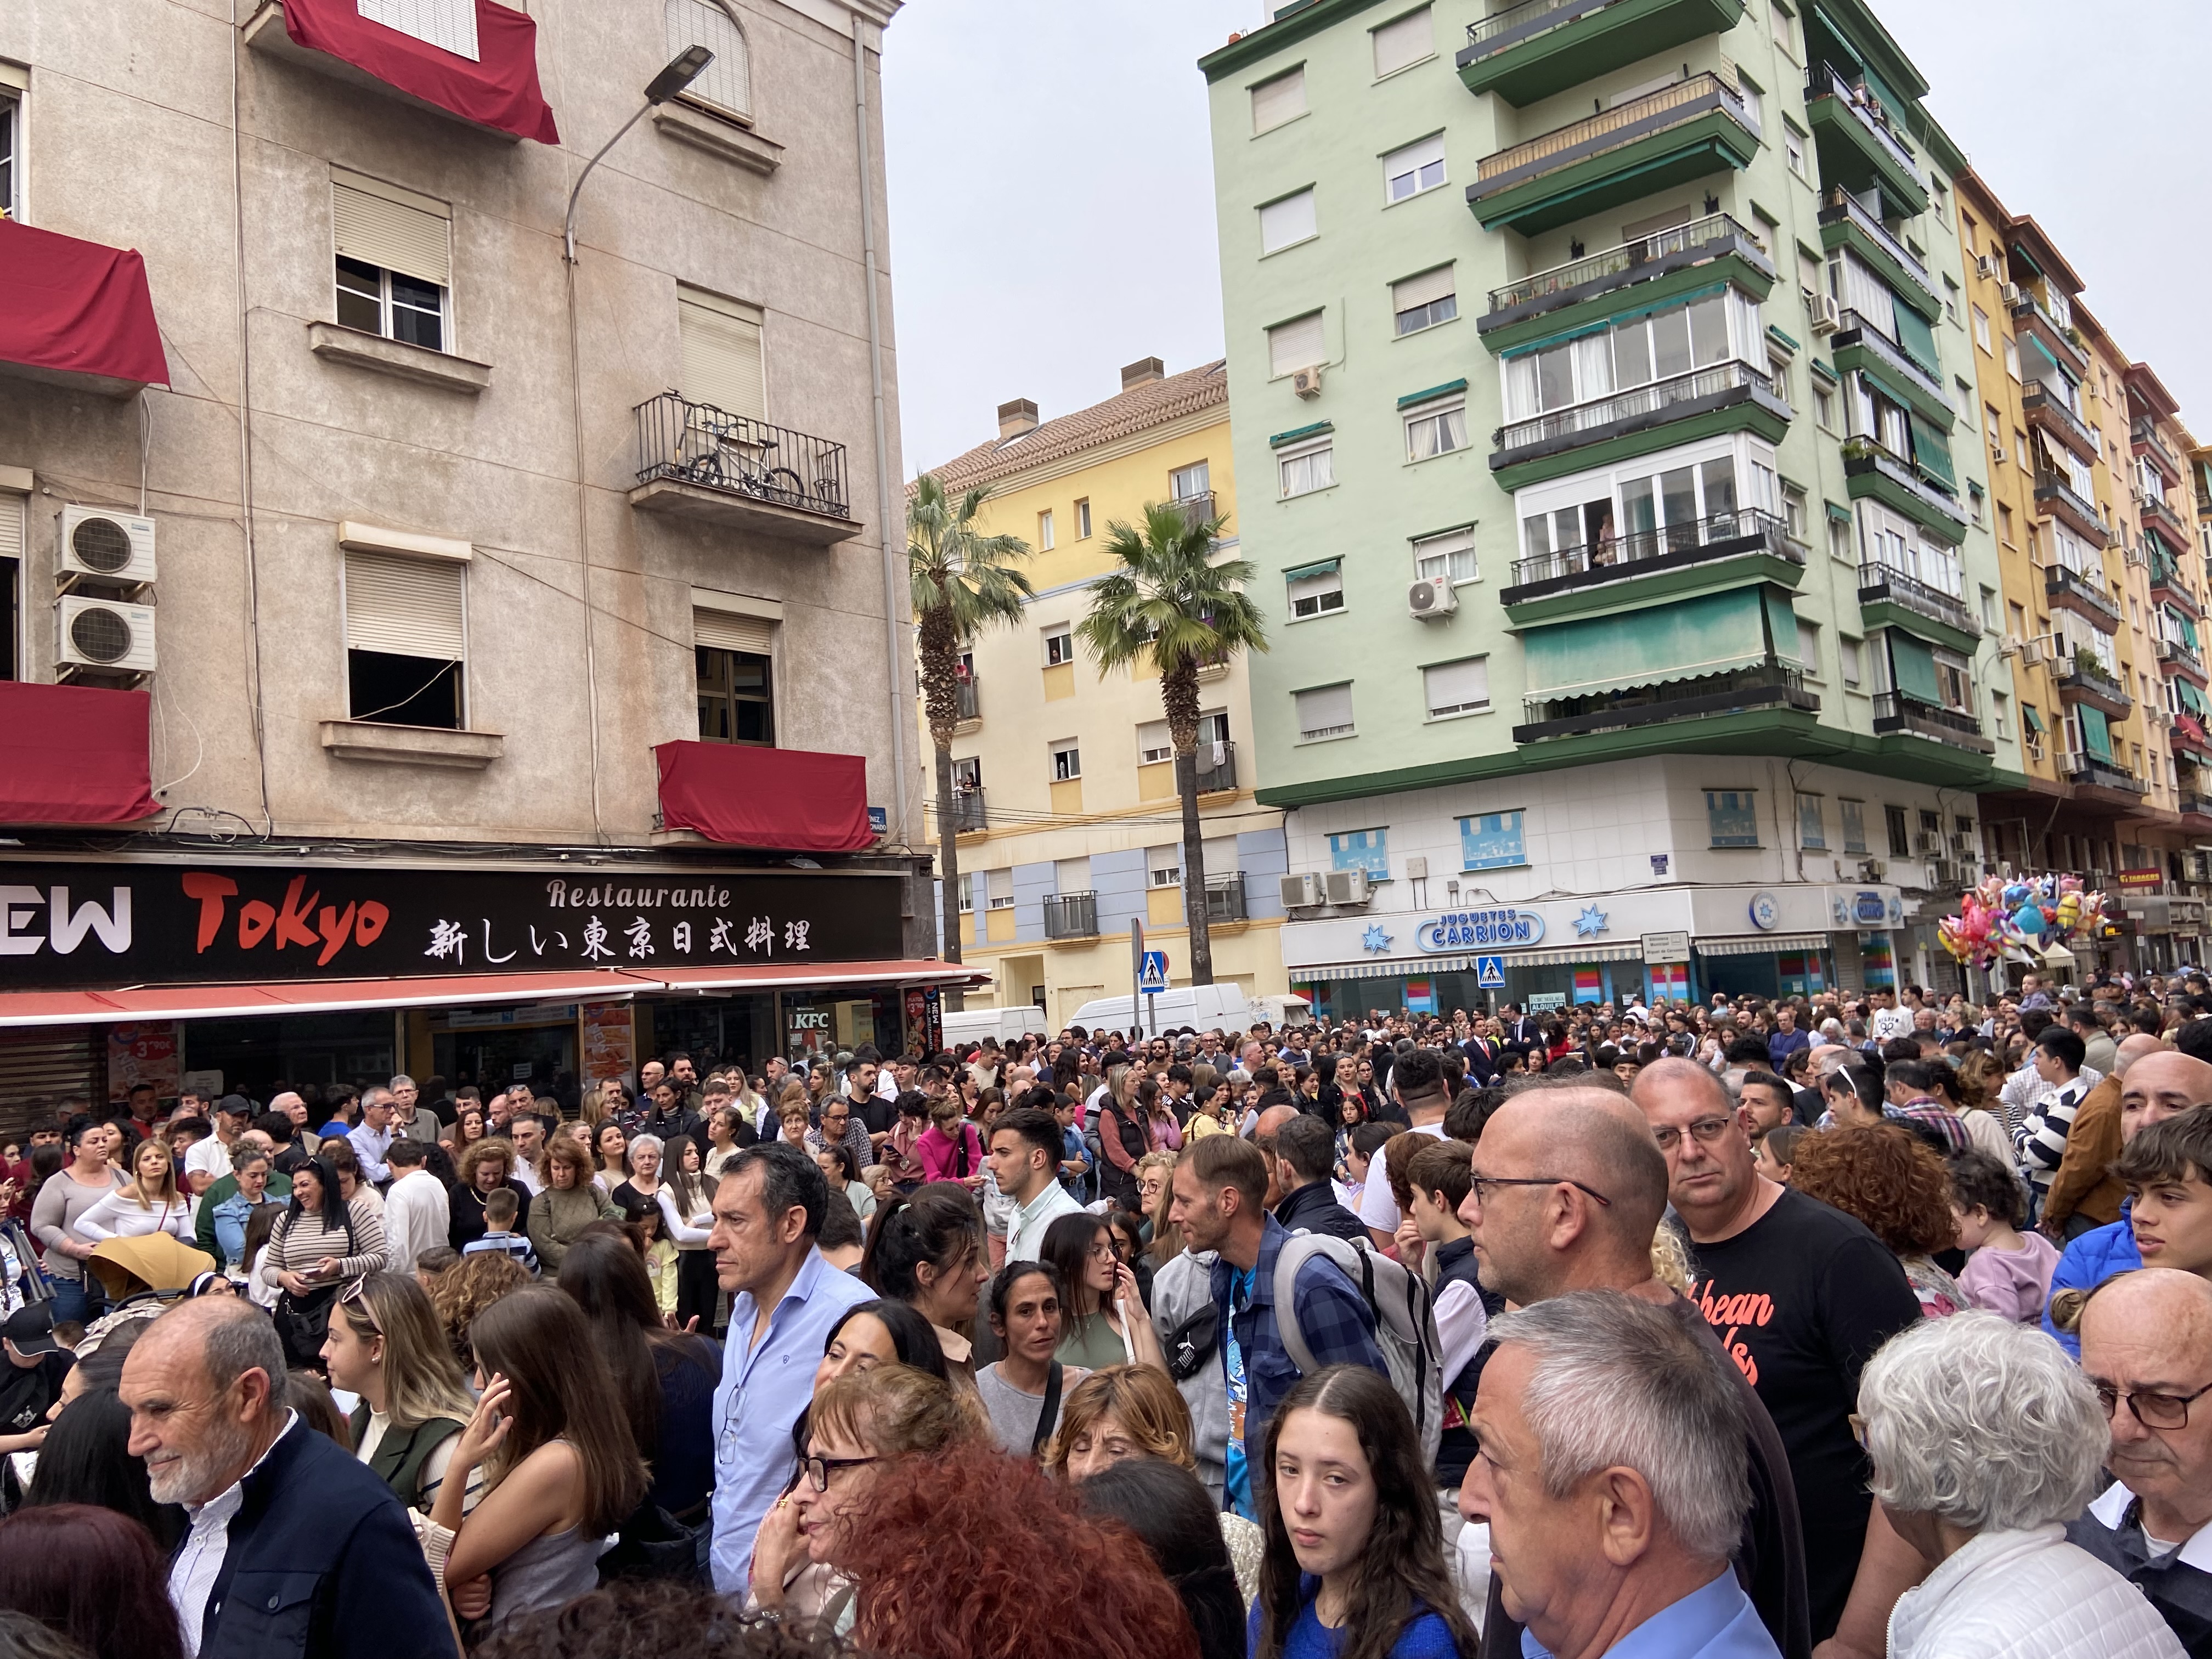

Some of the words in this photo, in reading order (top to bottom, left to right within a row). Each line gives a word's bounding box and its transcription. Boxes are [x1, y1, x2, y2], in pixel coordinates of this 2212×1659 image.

[546, 879, 732, 908] Restaurante
[182, 872, 390, 966] Tokyo
[1440, 909, 1516, 926] JUGUETES
[424, 915, 811, 966] 新しい東京日式料理
[1432, 921, 1530, 946] CARRION
[795, 1013, 829, 1029] KFC
